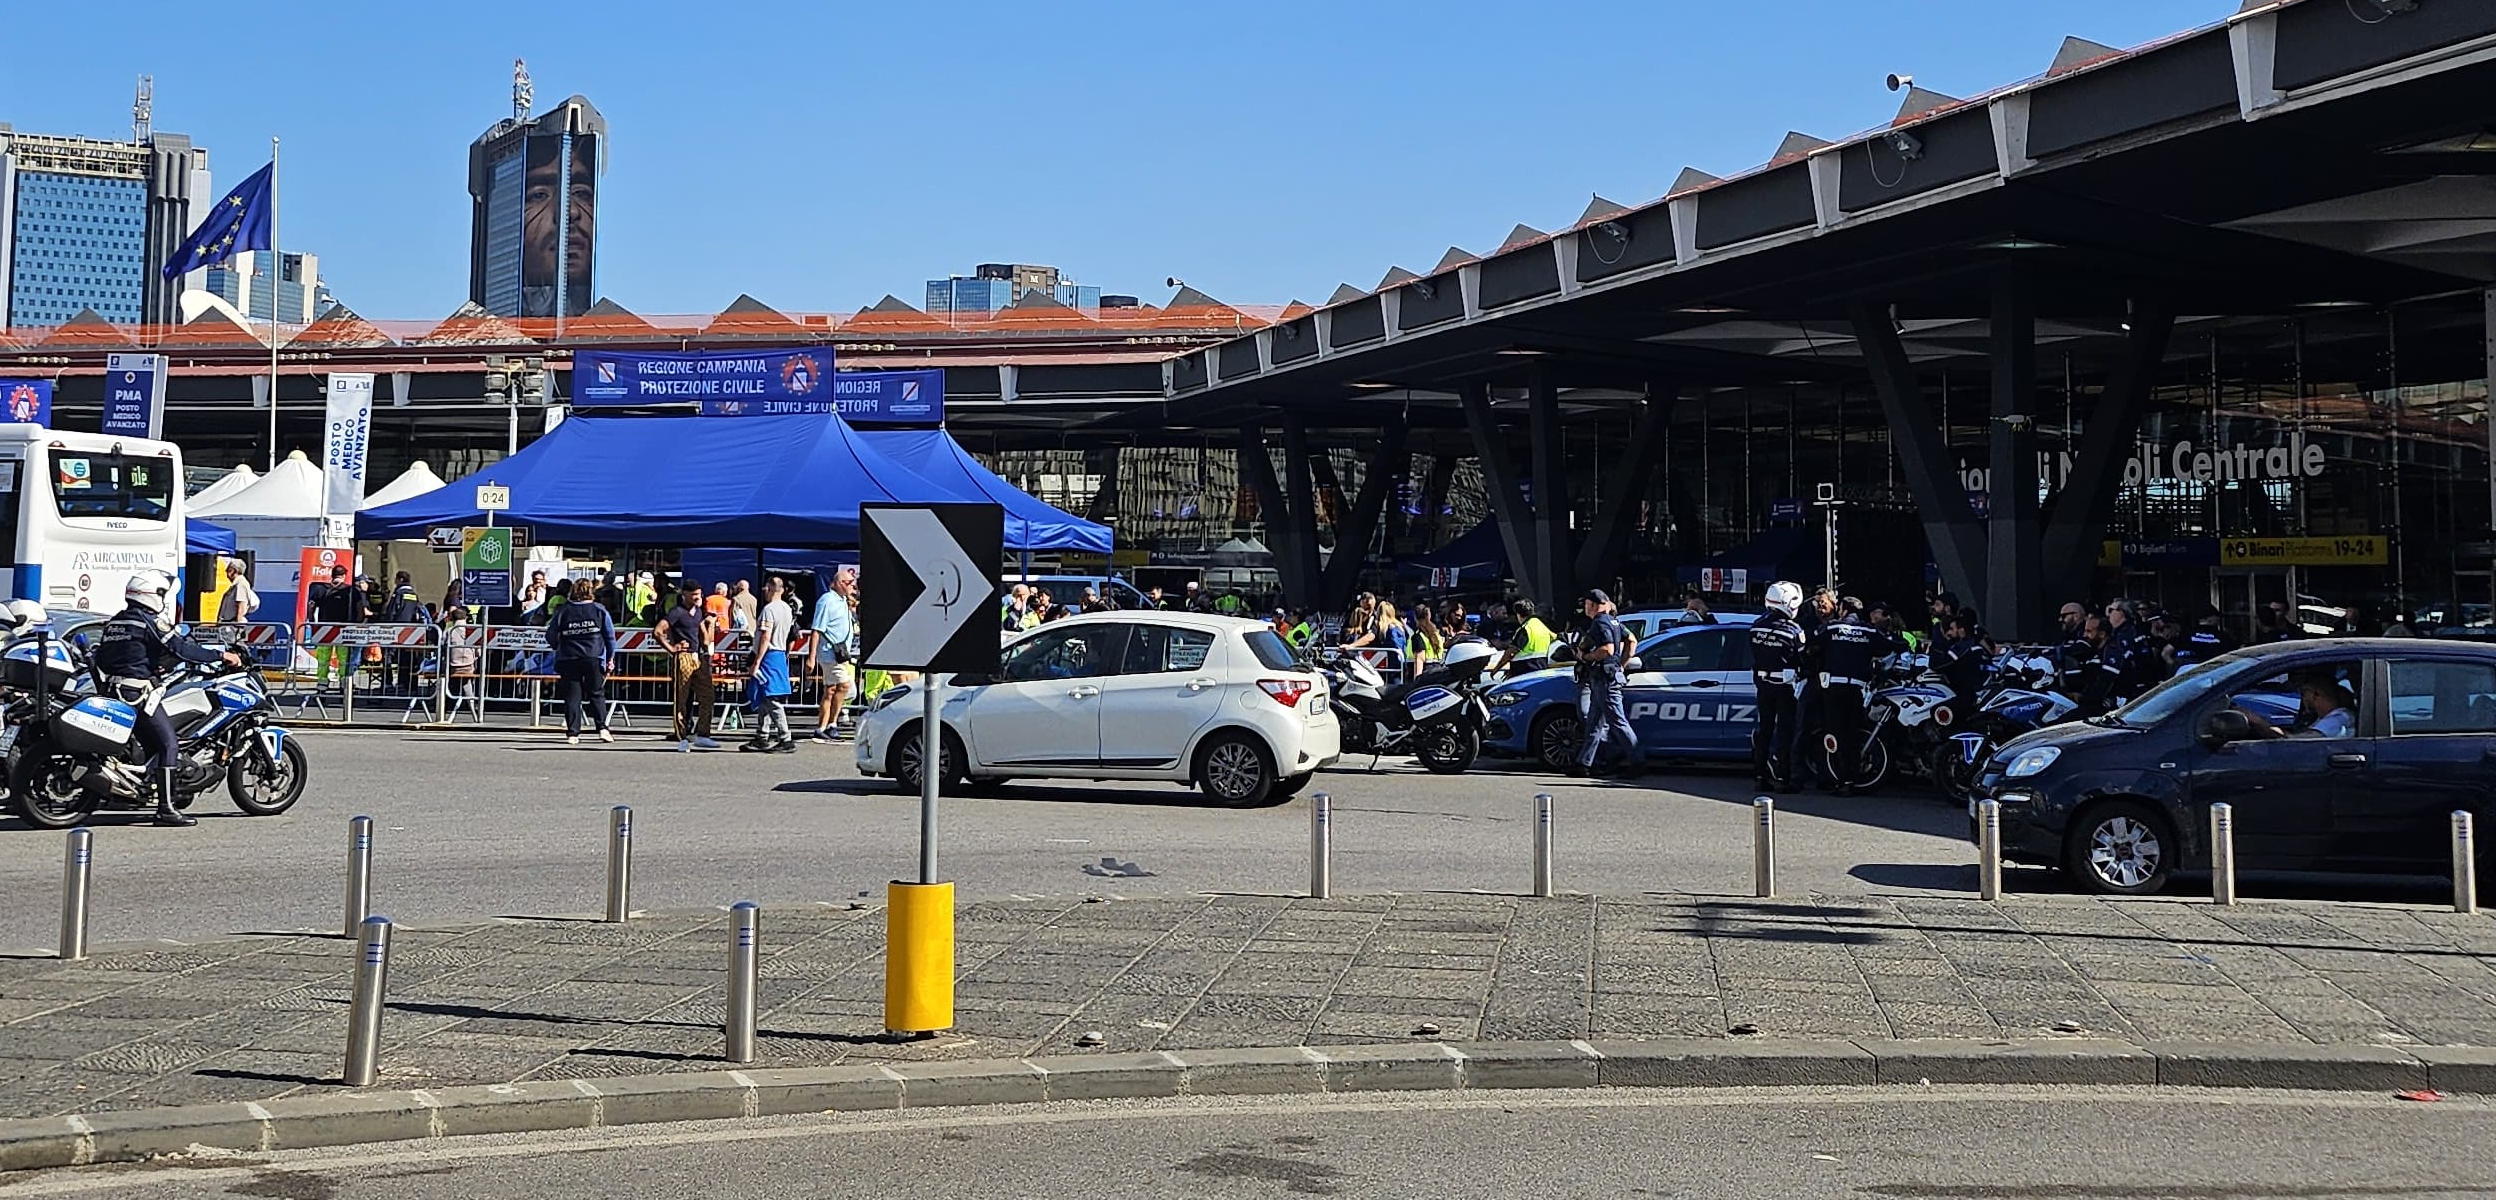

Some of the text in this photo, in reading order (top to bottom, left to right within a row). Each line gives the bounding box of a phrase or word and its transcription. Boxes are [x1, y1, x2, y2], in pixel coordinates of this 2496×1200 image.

[637, 359, 768, 375] REGIONE CAMPANIA
[115, 389, 142, 401] PMA
[639, 380, 720, 395] PROTEZIONE
[722, 379, 765, 394] CIVILE
[113, 412, 141, 420] MEDICO
[115, 404, 140, 412] POSTO
[105, 420, 147, 429] AVANZATO
[330, 422, 342, 466] POSTO
[342, 418, 355, 470] MEDICO
[352, 407, 368, 480] AVANZATO
[2172, 431, 2325, 482] Centrale
[106, 521, 128, 529] IVECO
[2249, 541, 2285, 556] Binari
[2334, 540, 2374, 557] 19-24
[93, 552, 154, 564] AIRCAMPANIA
[568, 620, 596, 629] POLIZIA
[1629, 702, 1760, 722] POLIZ
